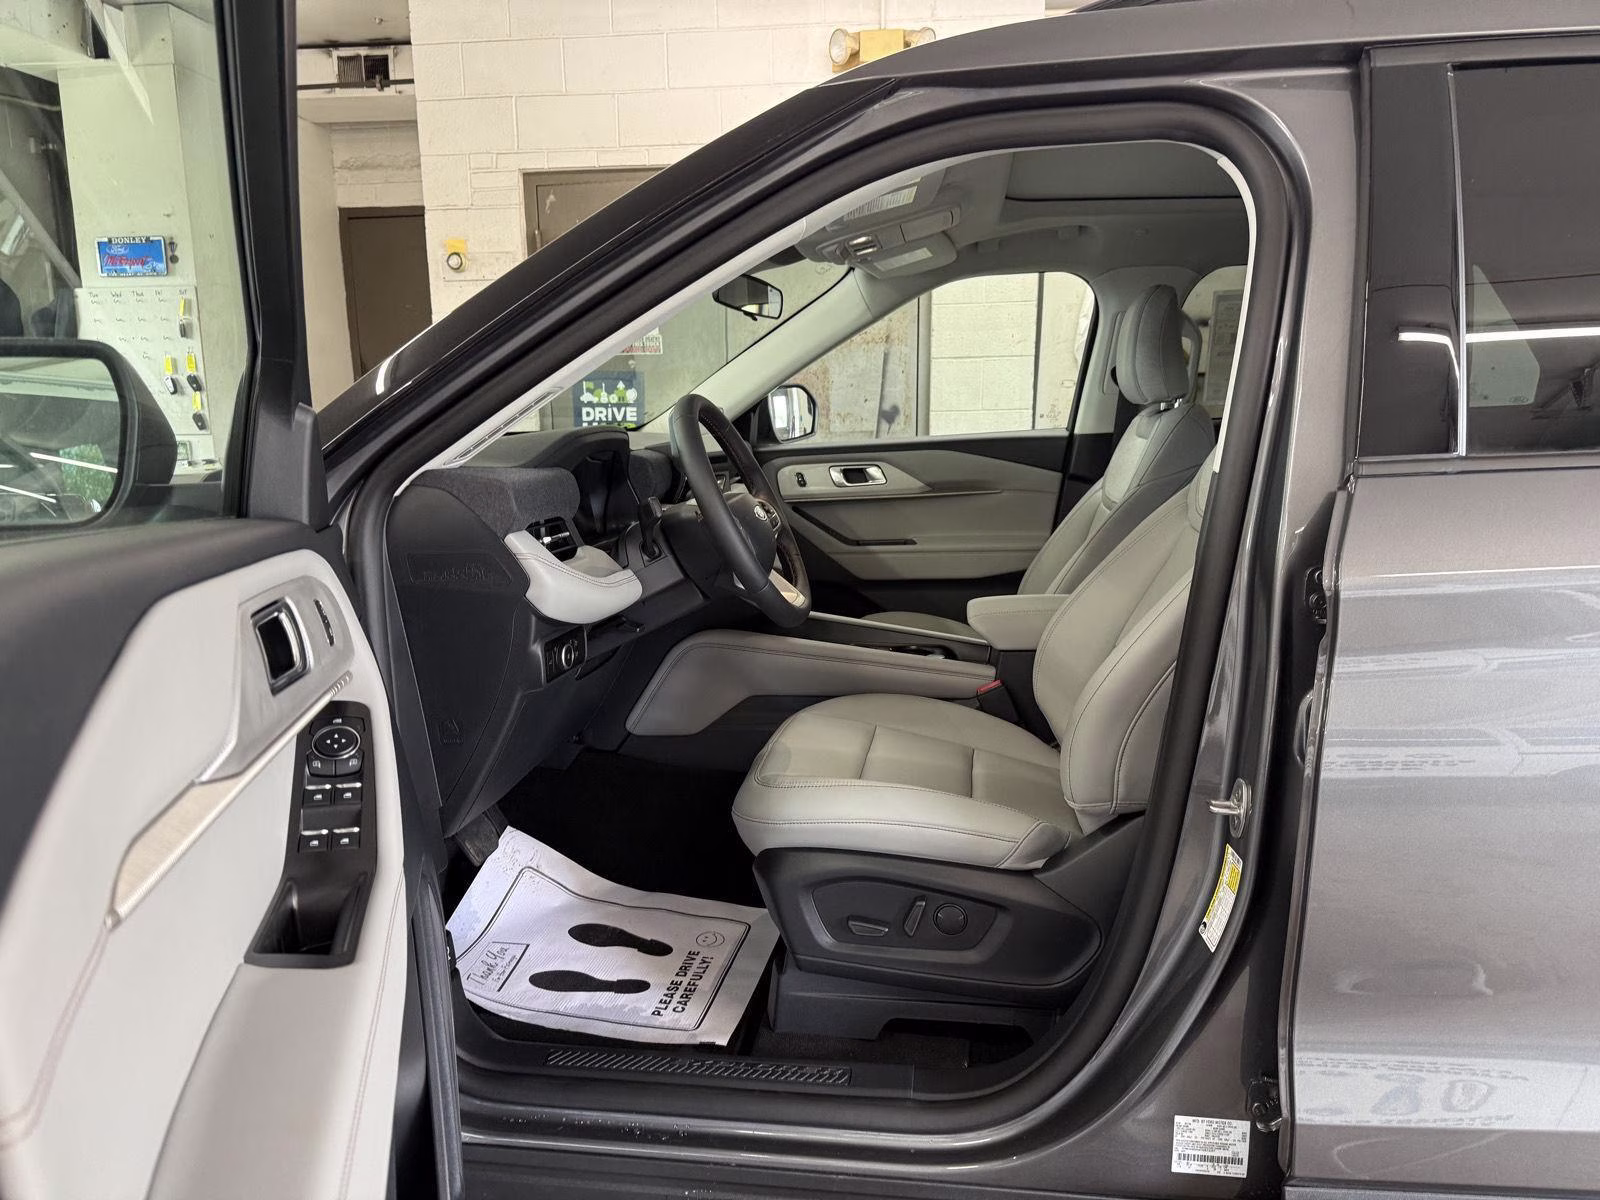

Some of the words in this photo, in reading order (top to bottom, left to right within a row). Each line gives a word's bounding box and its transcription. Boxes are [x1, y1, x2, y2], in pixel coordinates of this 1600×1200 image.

[111, 236, 147, 244] DONLEY
[466, 960, 499, 986] Thank
[485, 946, 510, 960] You
[651, 980, 683, 1017] PLEASE
[675, 950, 700, 978] DRIVE
[672, 956, 714, 1014] CAREFULLY!
